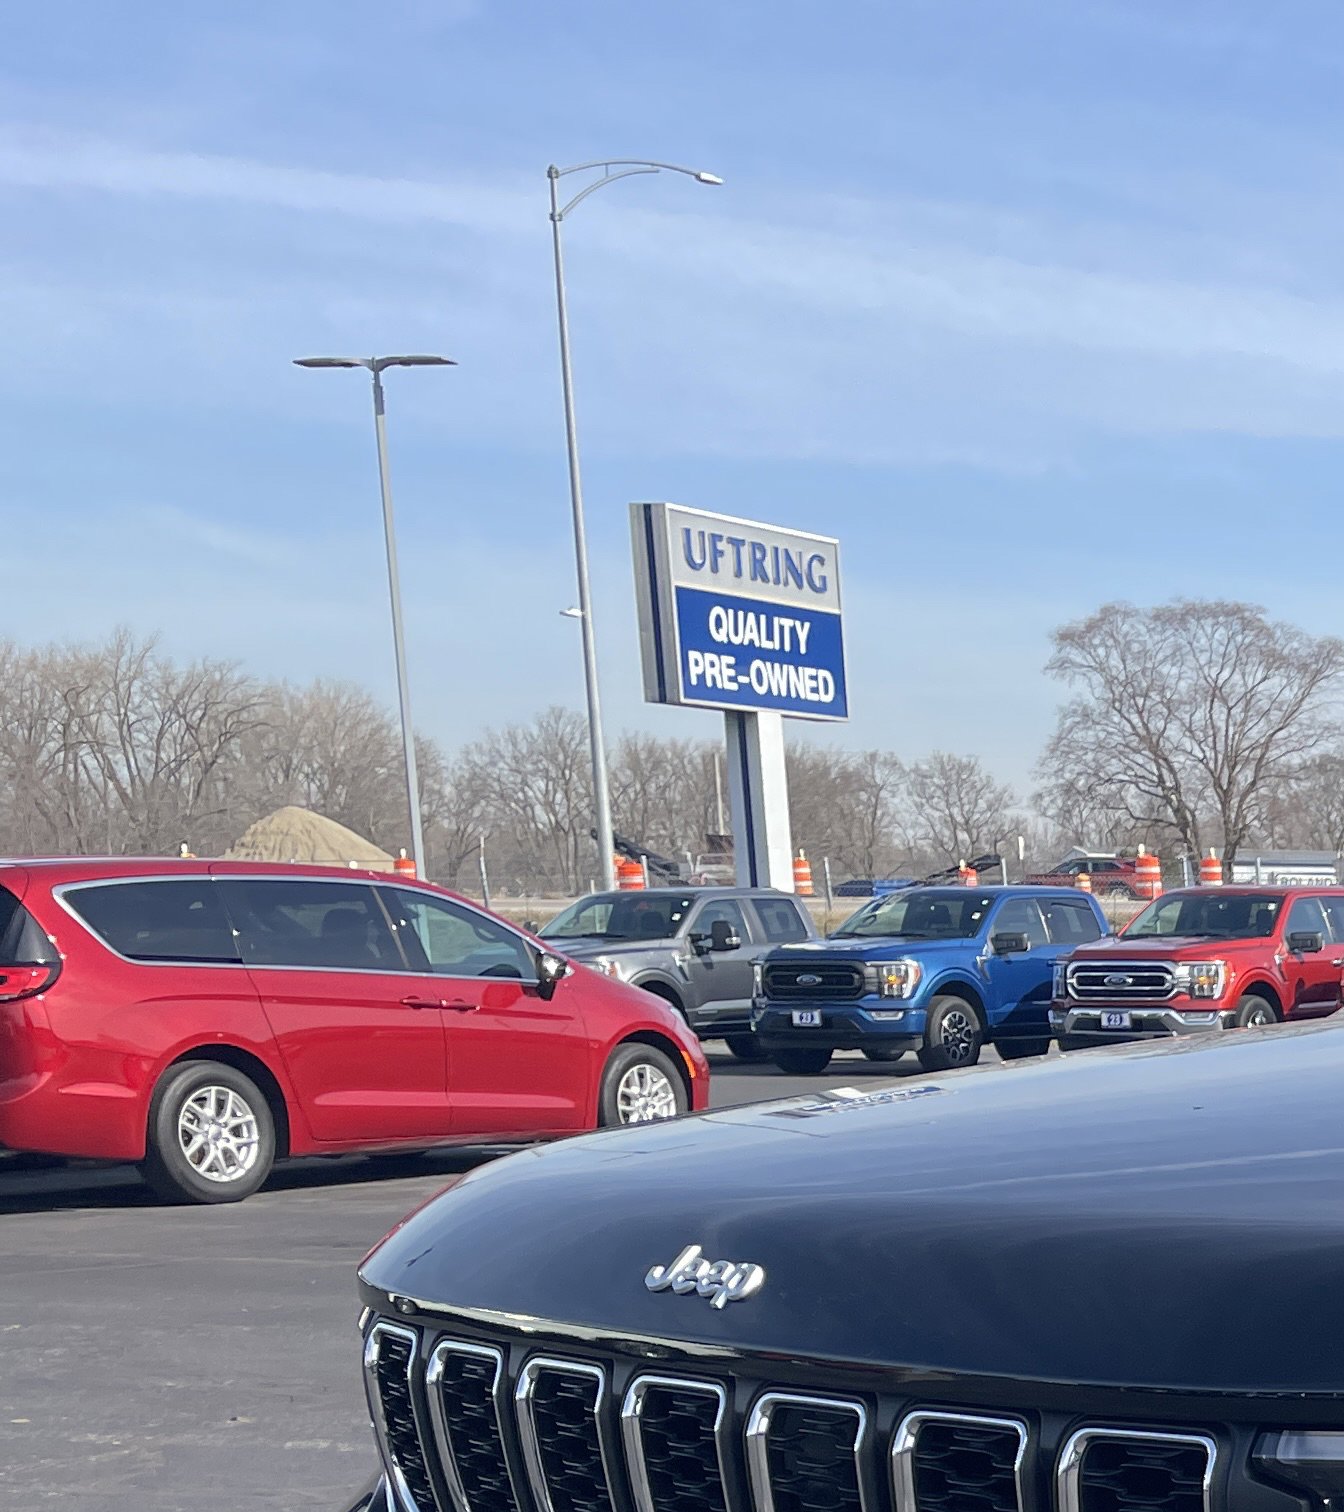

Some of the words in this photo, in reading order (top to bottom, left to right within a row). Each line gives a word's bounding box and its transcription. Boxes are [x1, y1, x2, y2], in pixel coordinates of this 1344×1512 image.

[681, 527, 828, 593] UFTRING
[708, 605, 811, 655] QUALITY
[687, 650, 835, 703] PRE-OWNED
[645, 1244, 765, 1310] Jeep
